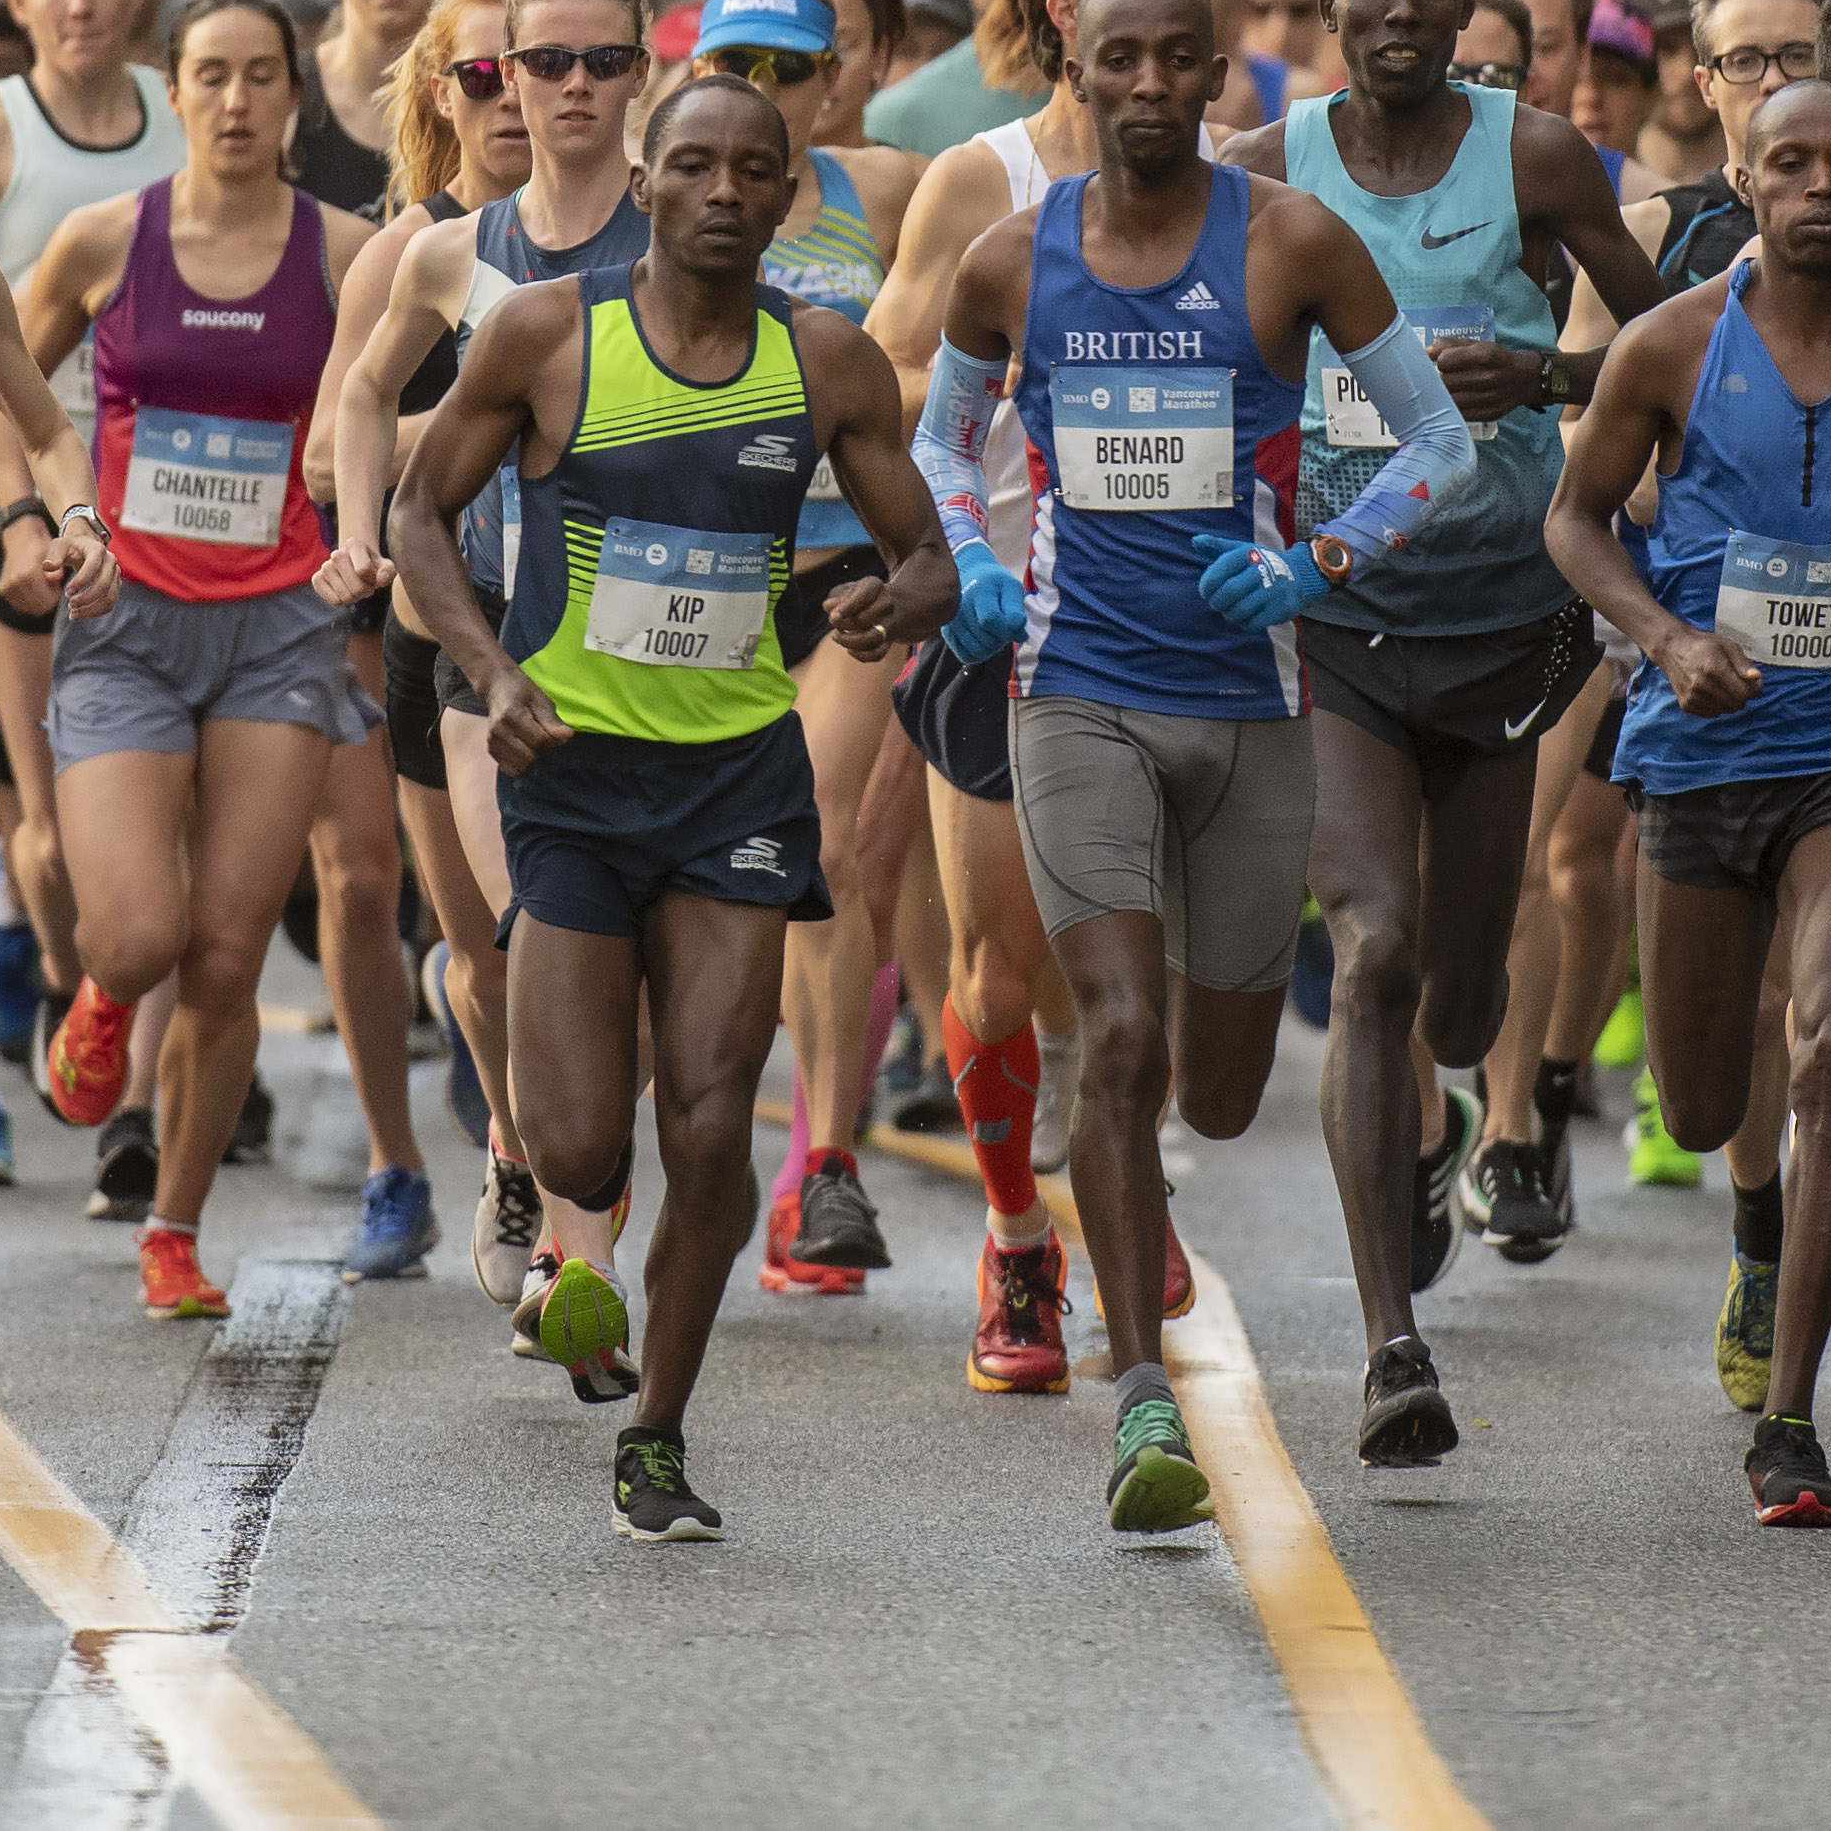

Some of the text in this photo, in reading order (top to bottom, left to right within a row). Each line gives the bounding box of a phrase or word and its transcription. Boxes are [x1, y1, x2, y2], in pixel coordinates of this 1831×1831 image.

[1175, 299, 1221, 310] adidas
[182, 308, 265, 333] saucony
[1064, 330, 1203, 361] BRITISH
[1062, 394, 1089, 404] BMO
[1162, 389, 1221, 399] Vancouver
[1162, 399, 1217, 410] Marathon
[738, 450, 797, 468] SKECHERS
[1096, 436, 1184, 465] BENARD
[153, 467, 263, 505] CHANTELLE
[1104, 473, 1170, 499] 10005
[174, 503, 232, 532] 10058
[613, 543, 643, 557] BMO
[1736, 557, 1764, 571] BMO
[667, 594, 705, 625] KIP
[645, 628, 709, 659] 10007
